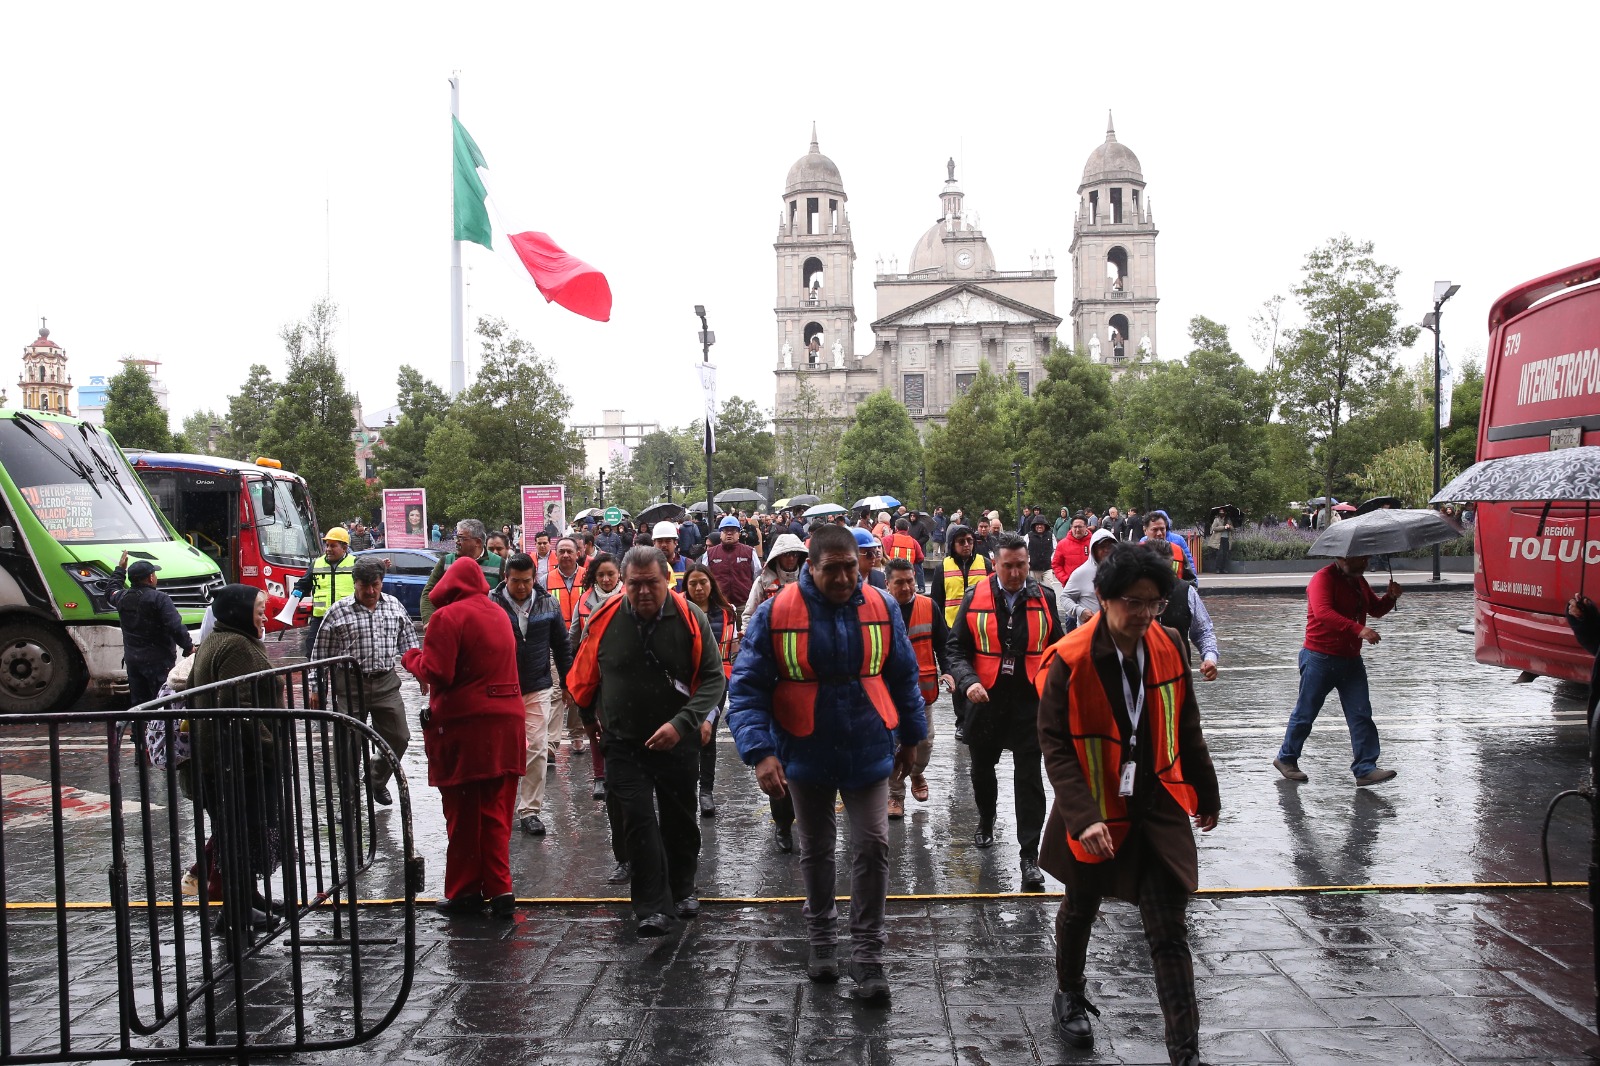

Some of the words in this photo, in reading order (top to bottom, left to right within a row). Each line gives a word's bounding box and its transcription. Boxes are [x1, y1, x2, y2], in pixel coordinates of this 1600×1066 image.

[1504, 332, 1521, 357] 579
[1544, 524, 1575, 537] REGIÓN
[1536, 585, 1543, 597] 25
